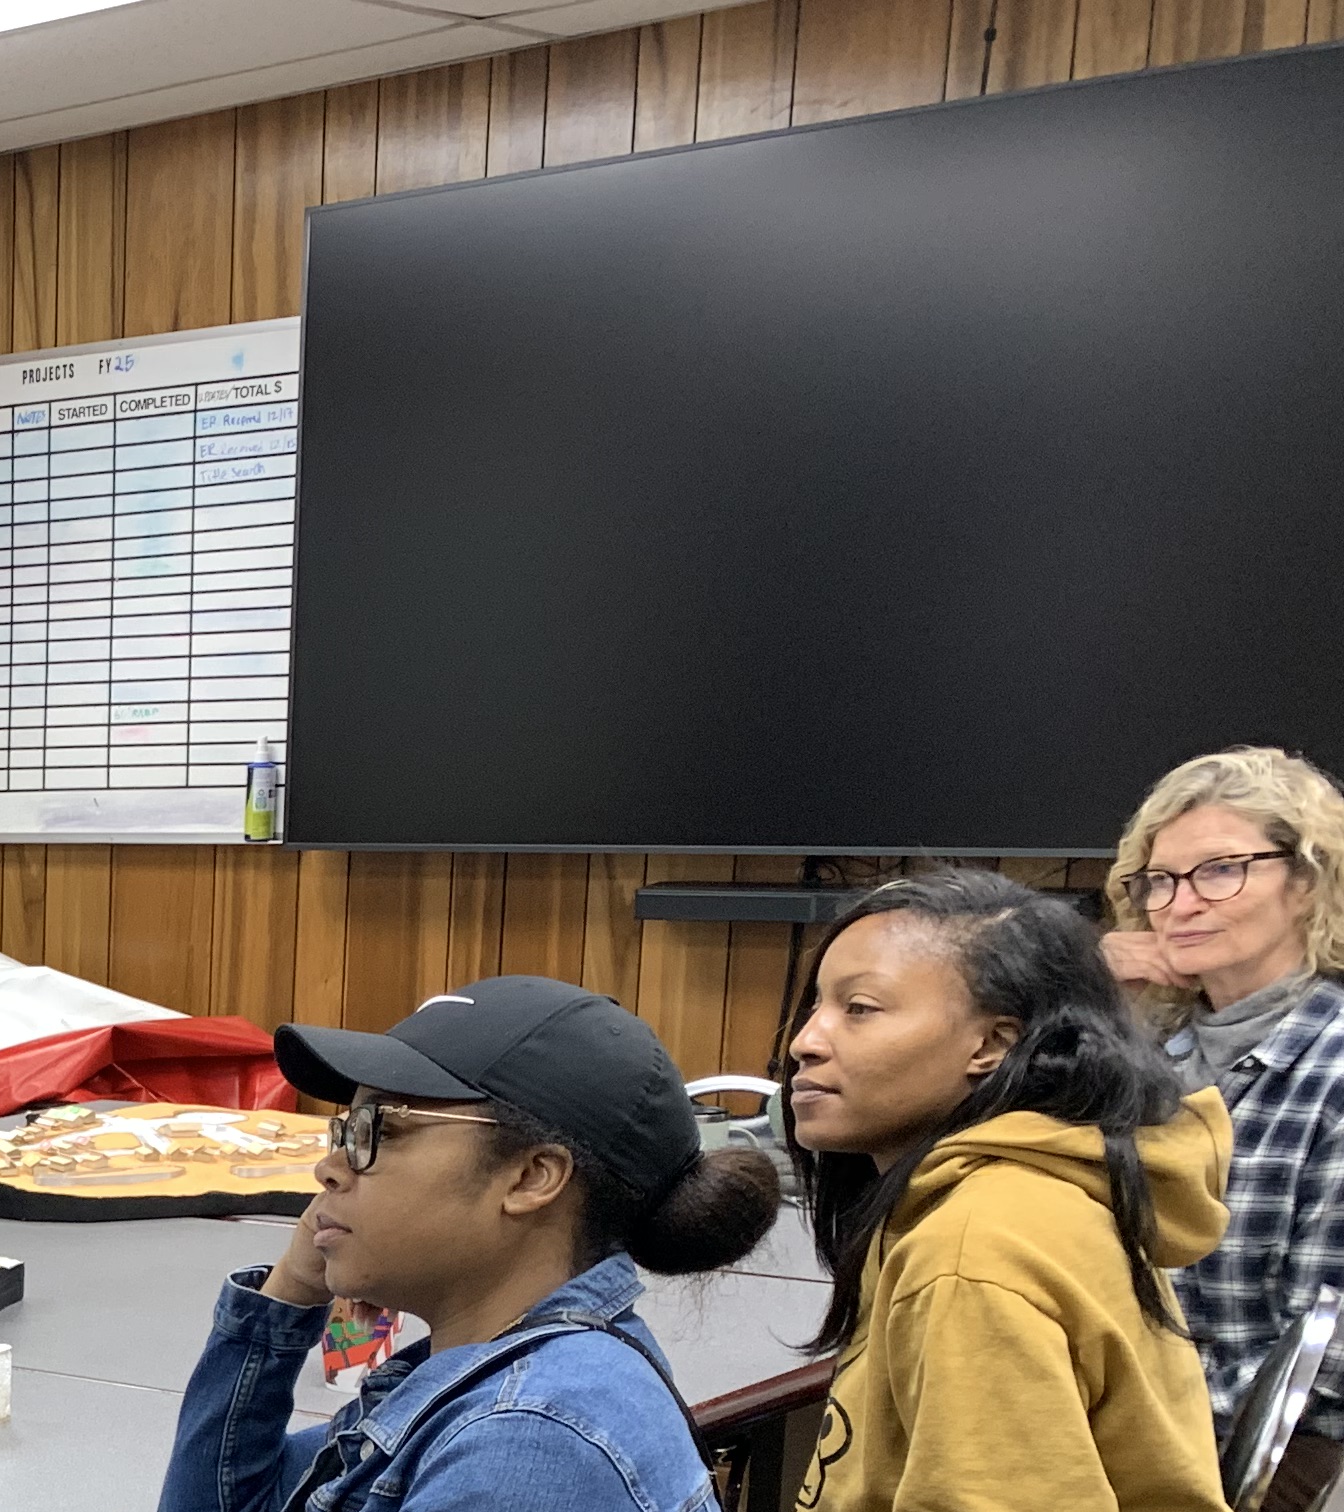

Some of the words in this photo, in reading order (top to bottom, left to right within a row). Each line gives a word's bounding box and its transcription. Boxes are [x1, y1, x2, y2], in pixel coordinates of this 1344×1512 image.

[22, 363, 75, 385] PROJECTS
[58, 404, 108, 421] STARTED
[119, 394, 191, 413] COMPLETED
